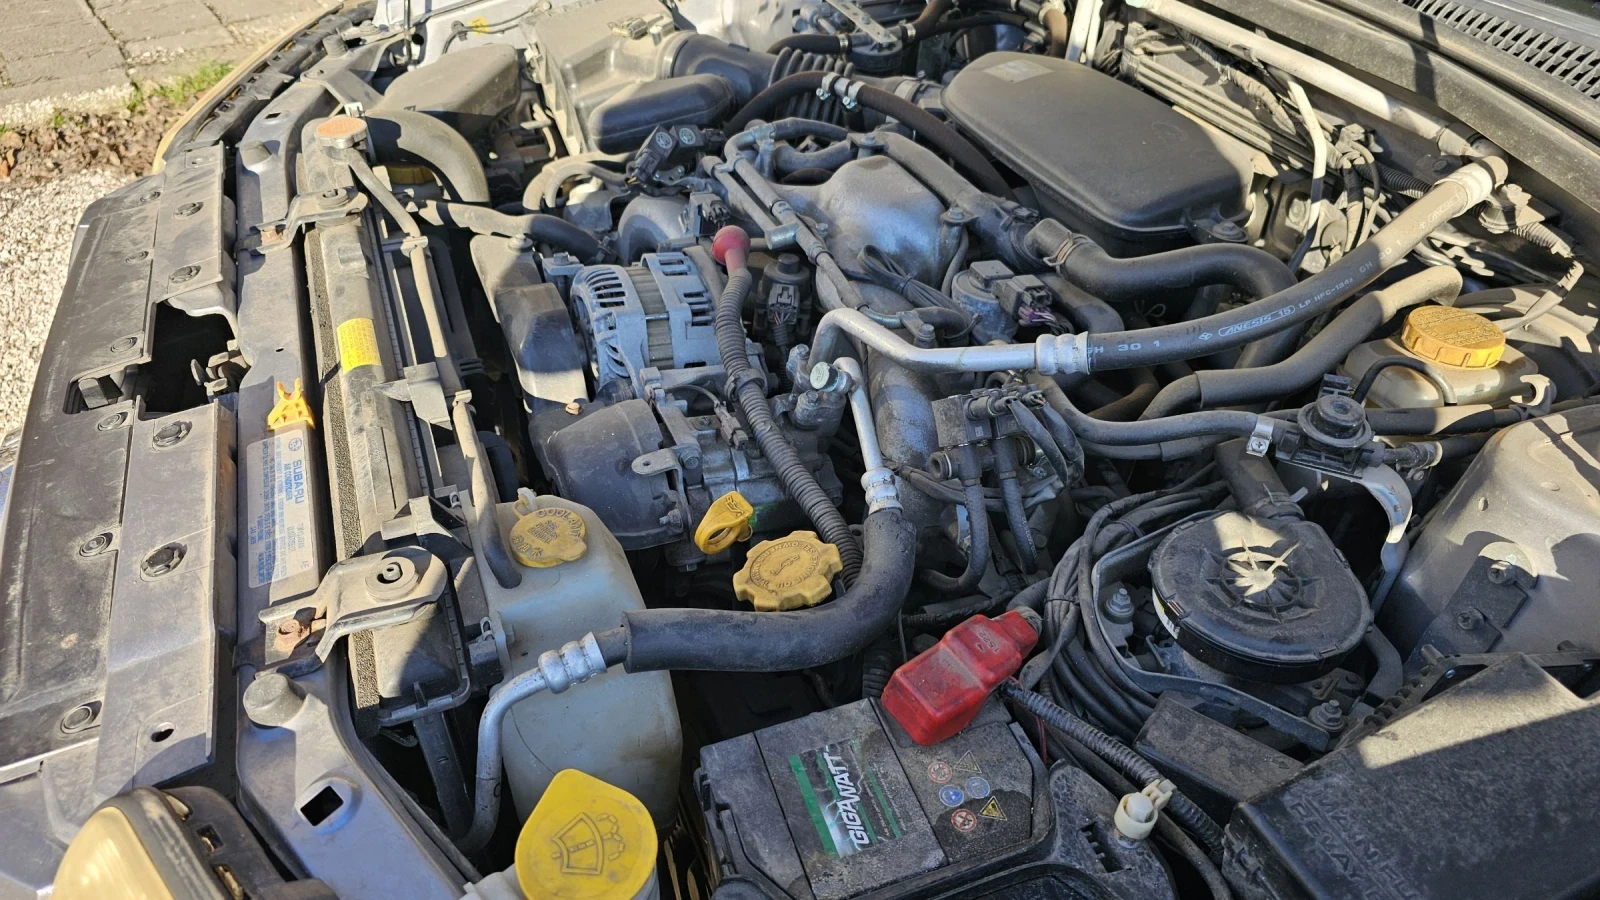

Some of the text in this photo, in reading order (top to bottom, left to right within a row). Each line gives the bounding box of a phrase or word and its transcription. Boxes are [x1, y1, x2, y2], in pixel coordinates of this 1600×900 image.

[1224, 315, 1272, 335] ANESIS
[1278, 307, 1291, 318] 15
[1299, 299, 1311, 309] LP
[1313, 277, 1353, 302] HFC-134a
[1359, 261, 1373, 273] GH
[1118, 342, 1142, 351] 30
[293, 460, 304, 504] SUBARU
[536, 508, 582, 538] COOLANT
[823, 751, 870, 845] GIGAWATT
